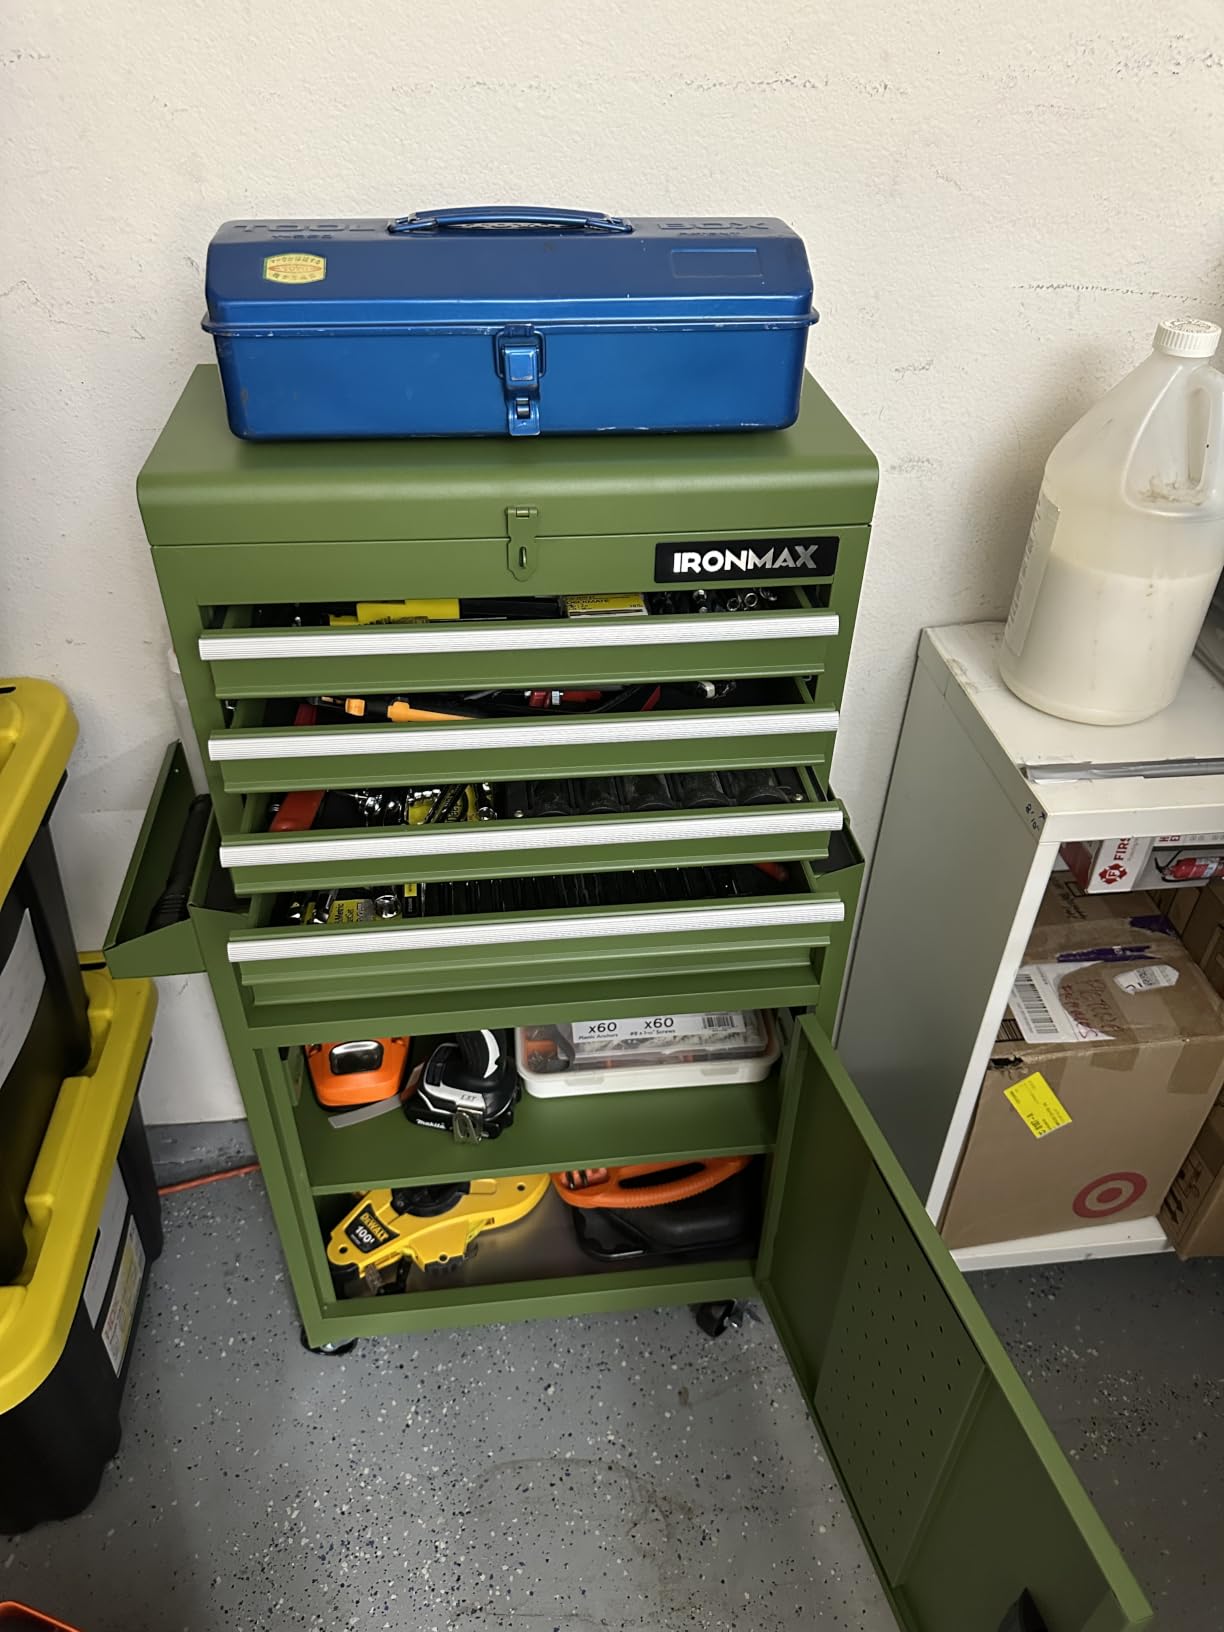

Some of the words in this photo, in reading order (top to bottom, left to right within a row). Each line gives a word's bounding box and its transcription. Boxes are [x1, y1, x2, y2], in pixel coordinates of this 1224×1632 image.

[673, 544, 818, 574] IRONMAX
[588, 1021, 618, 1034] x60
[644, 1016, 675, 1030] x60
[360, 1212, 389, 1242] DEWALT
